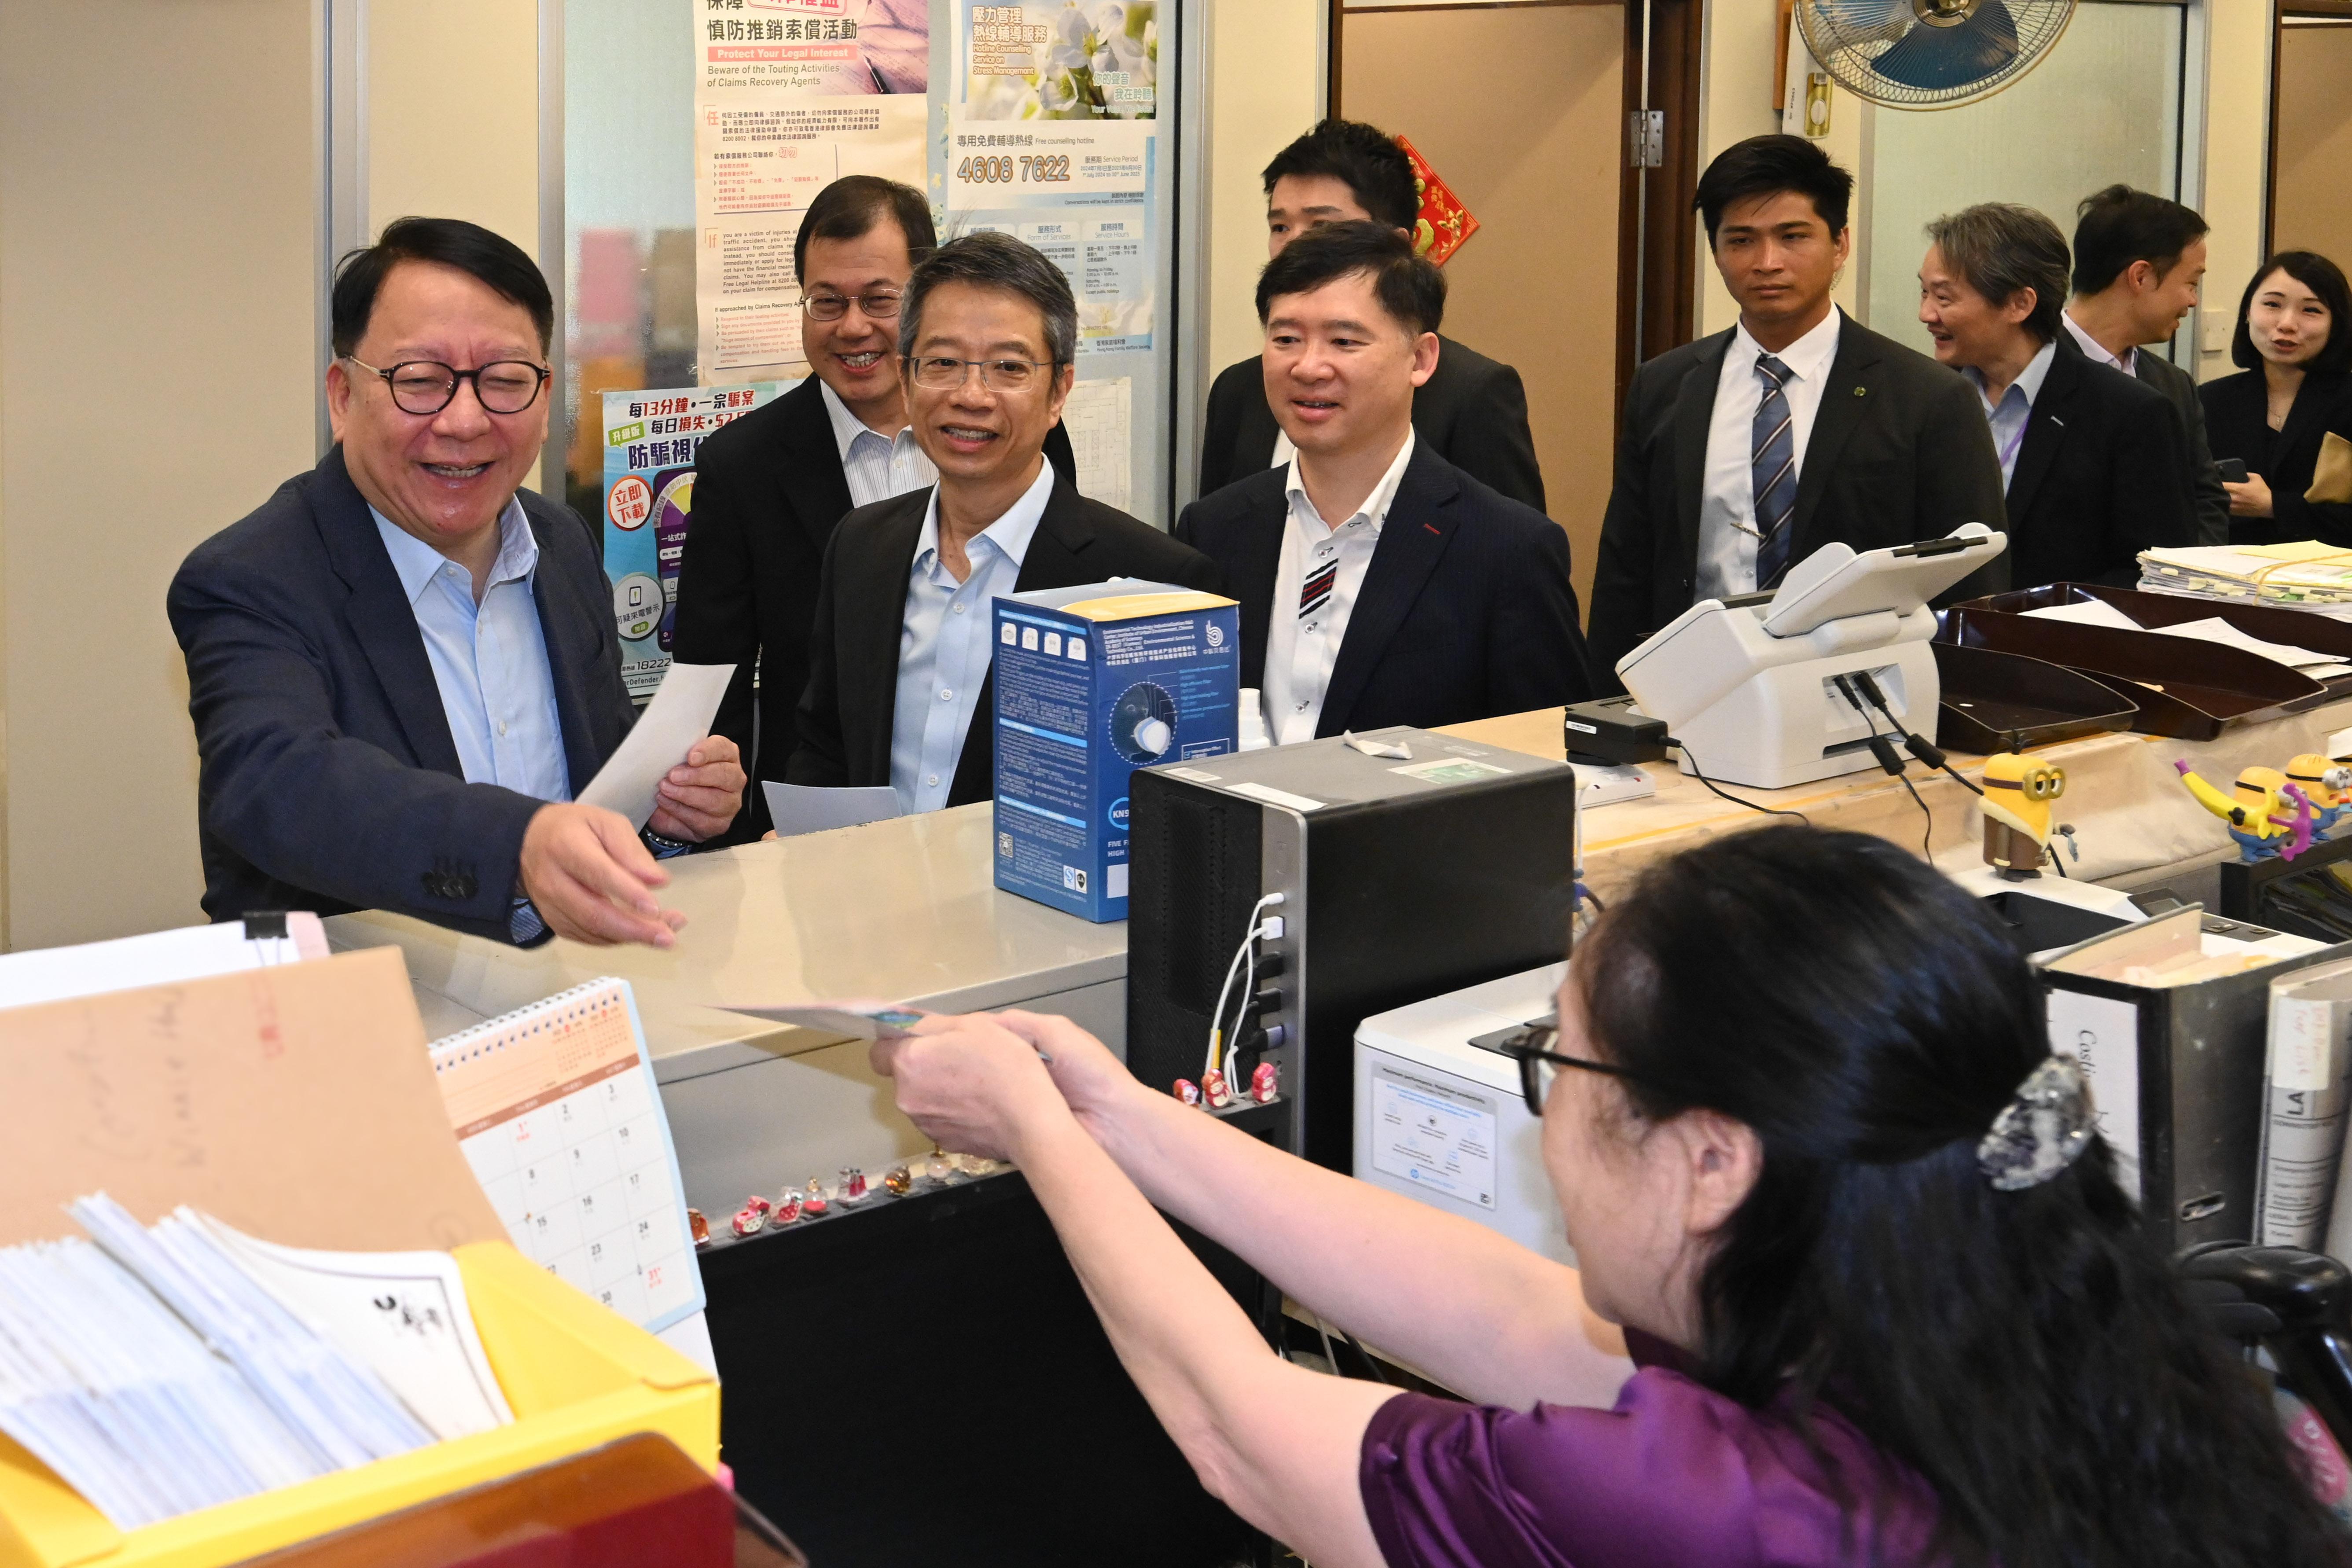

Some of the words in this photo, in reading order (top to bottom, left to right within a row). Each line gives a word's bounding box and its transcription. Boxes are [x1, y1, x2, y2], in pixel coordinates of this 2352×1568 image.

[972, 6, 1022, 23] 壓力管理
[707, 19, 857, 40] 慎防推銷索償活動
[973, 24, 1047, 43] 熱線輔導服務
[718, 49, 754, 59] Protect
[782, 48, 807, 59] Legal
[811, 48, 848, 57] Interest
[973, 44, 995, 53] Hotline
[996, 44, 1032, 55] Counselling
[973, 55, 995, 63] Service
[768, 65, 798, 74] Touting
[801, 64, 839, 73] Activities
[973, 66, 993, 75] Stress
[719, 78, 746, 86] Claims
[750, 77, 787, 88] Recovery
[791, 77, 820, 87] Agents
[1093, 72, 1129, 86] 你的聲音
[707, 111, 719, 125] 任
[957, 135, 1033, 147] 專用免費輔導熱線
[957, 155, 1014, 183] 4608
[1019, 154, 1070, 182] 7622
[709, 234, 717, 248] If
[612, 426, 640, 442] 升級版
[615, 484, 642, 506] 立即
[617, 502, 645, 523] 下載
[637, 658, 671, 670] 18222
[562, 1104, 568, 1114] 2
[609, 1083, 614, 1094] 3
[573, 1148, 580, 1159] 9
[618, 1127, 629, 1138] 10
[537, 1215, 547, 1227] 15
[582, 1195, 592, 1206] 16
[630, 1173, 639, 1185] 17
[591, 1243, 601, 1256] 23
[639, 1221, 648, 1233] 24
